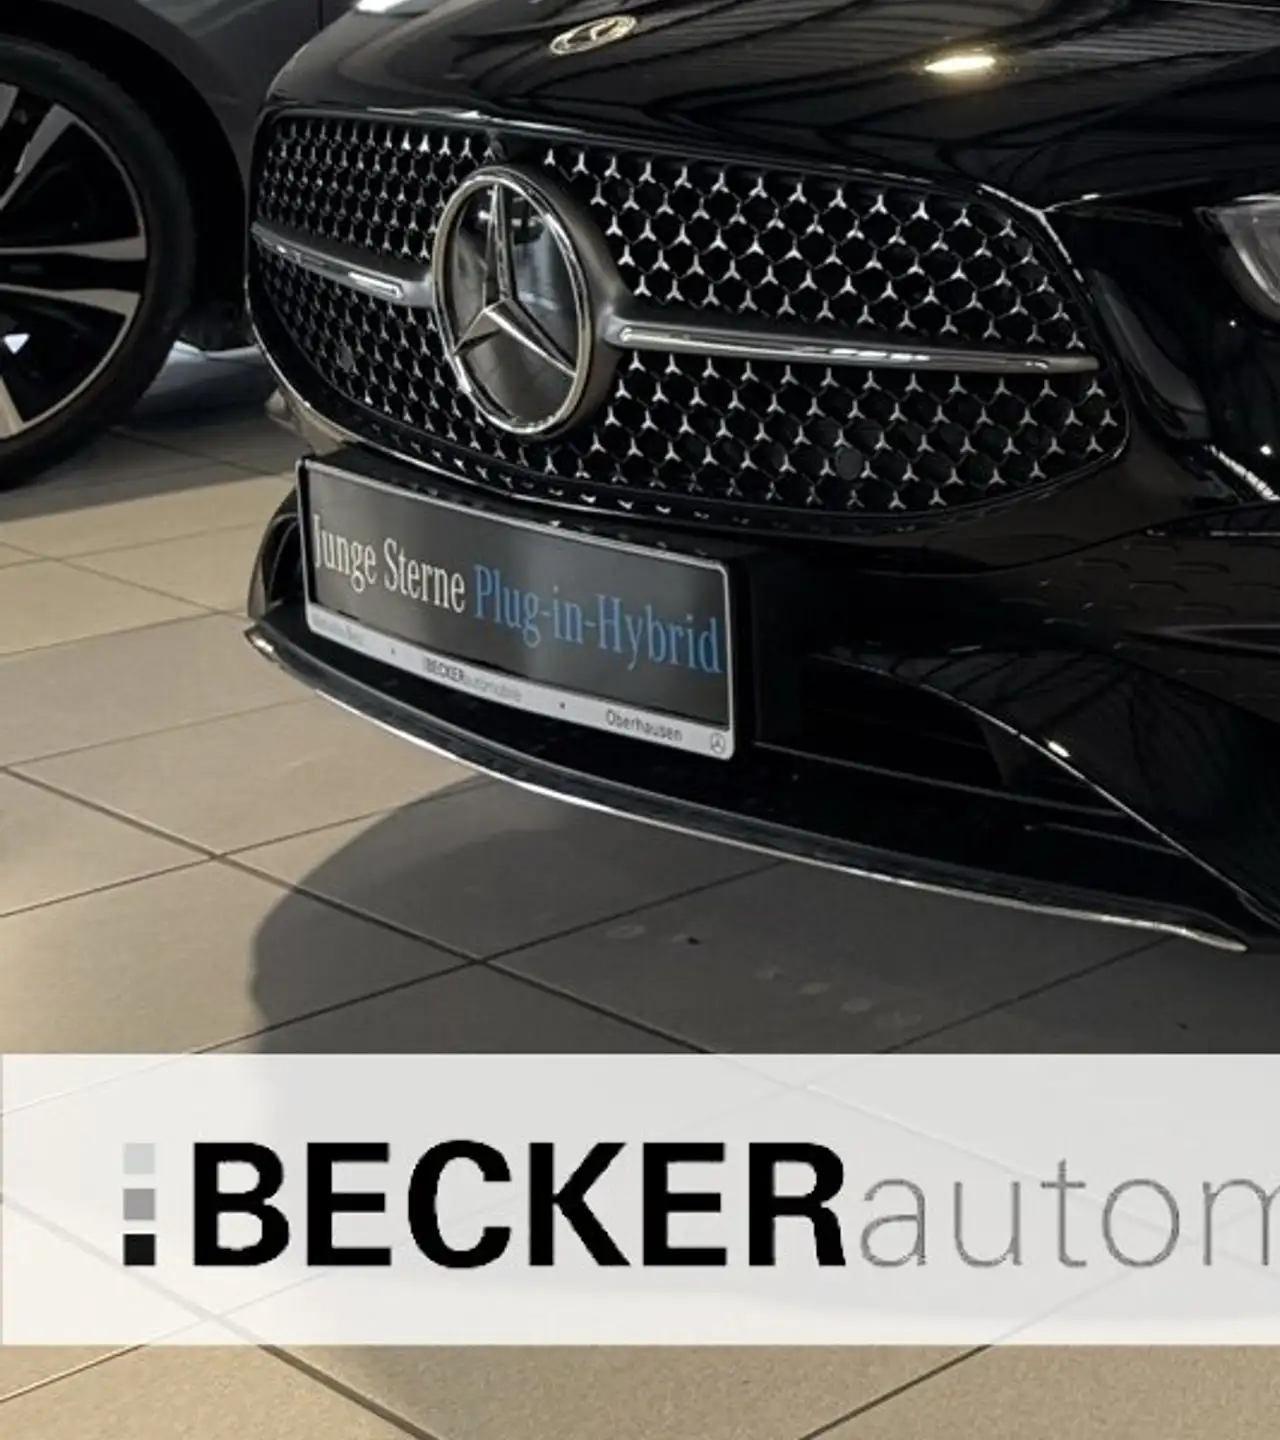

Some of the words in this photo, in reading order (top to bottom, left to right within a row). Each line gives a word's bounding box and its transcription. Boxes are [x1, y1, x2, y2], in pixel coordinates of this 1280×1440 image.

[313, 513, 377, 593] Junge
[383, 537, 466, 613] Sterne
[473, 563, 722, 674] Plug-in-Hybrid
